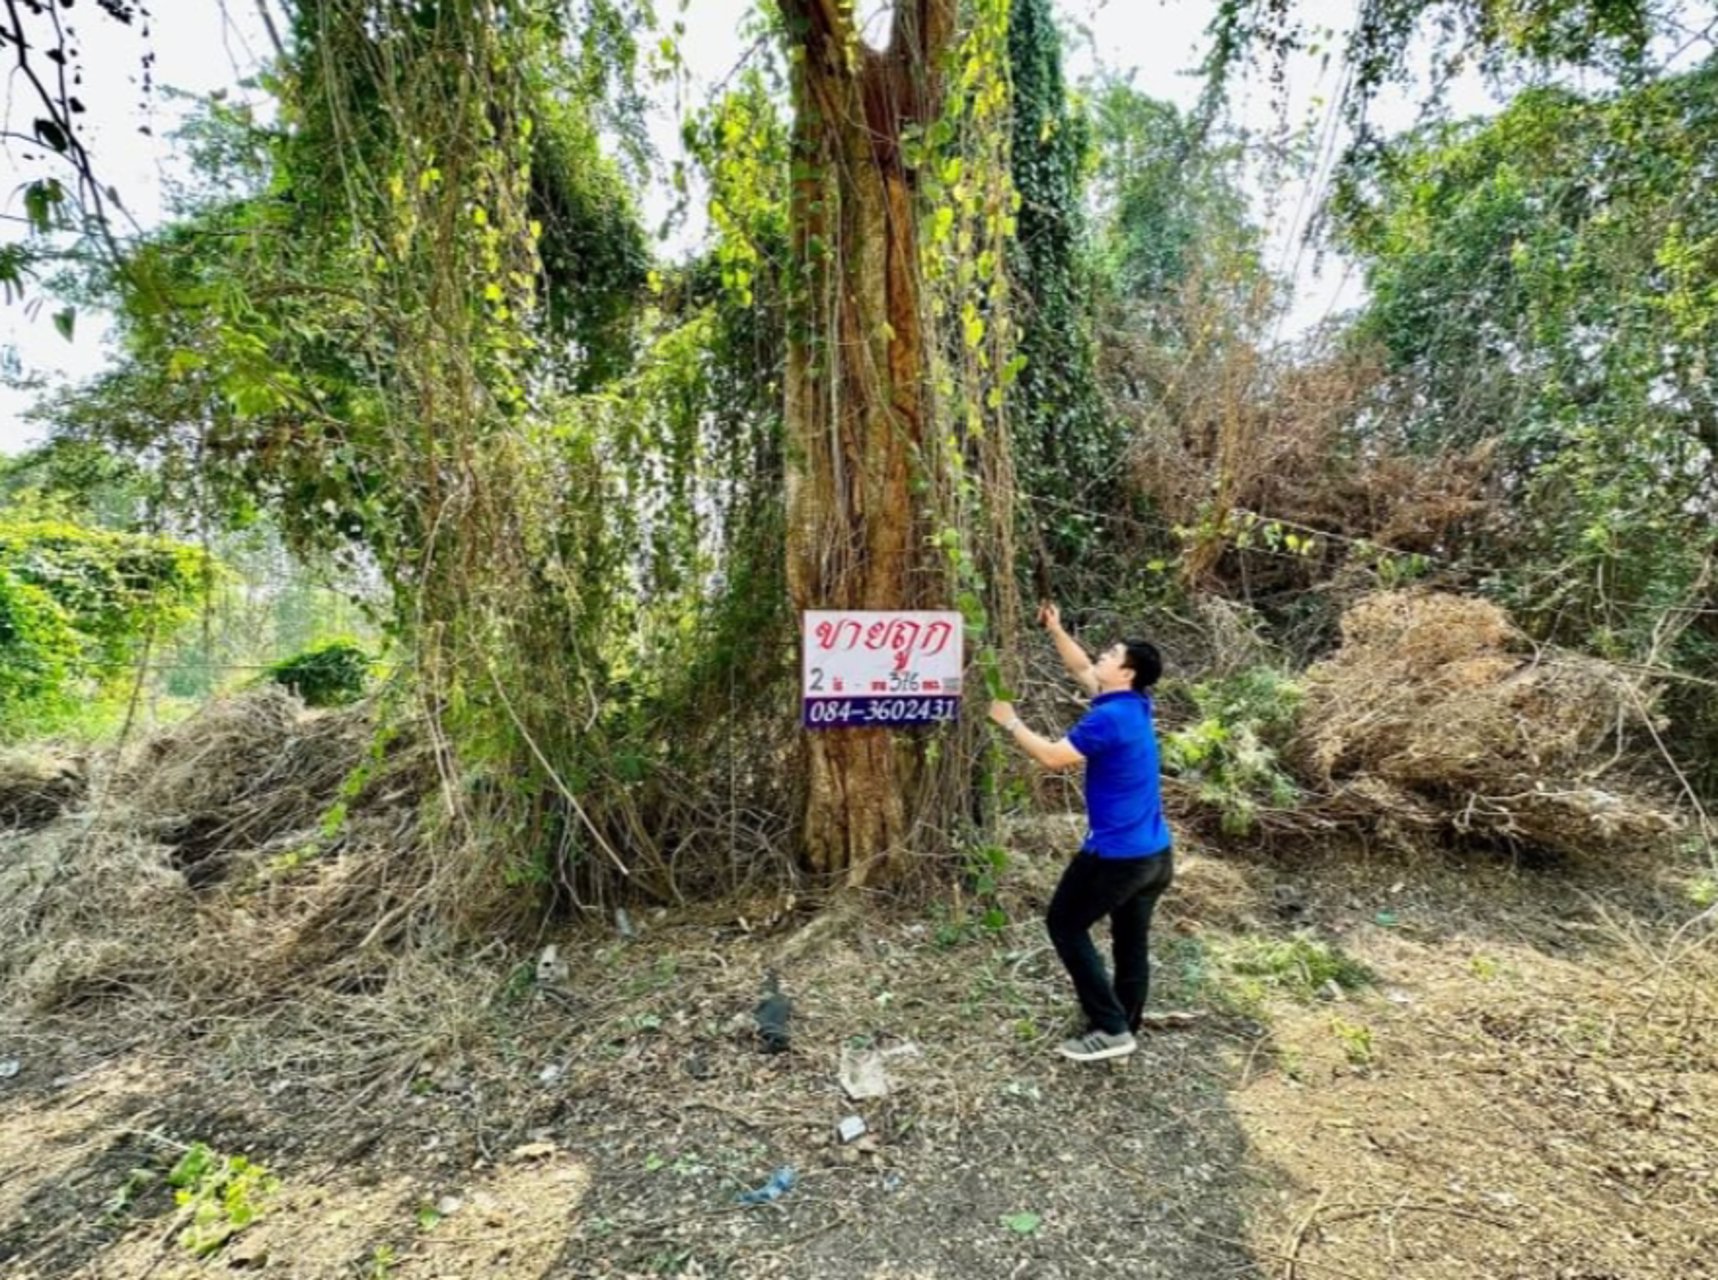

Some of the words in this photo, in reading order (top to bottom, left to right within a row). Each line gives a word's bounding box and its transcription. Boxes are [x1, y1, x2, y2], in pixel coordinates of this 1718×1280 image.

[815, 619, 953, 671] ขายถูก
[809, 667, 824, 691] 2
[809, 699, 955, 722] 084-3602431
